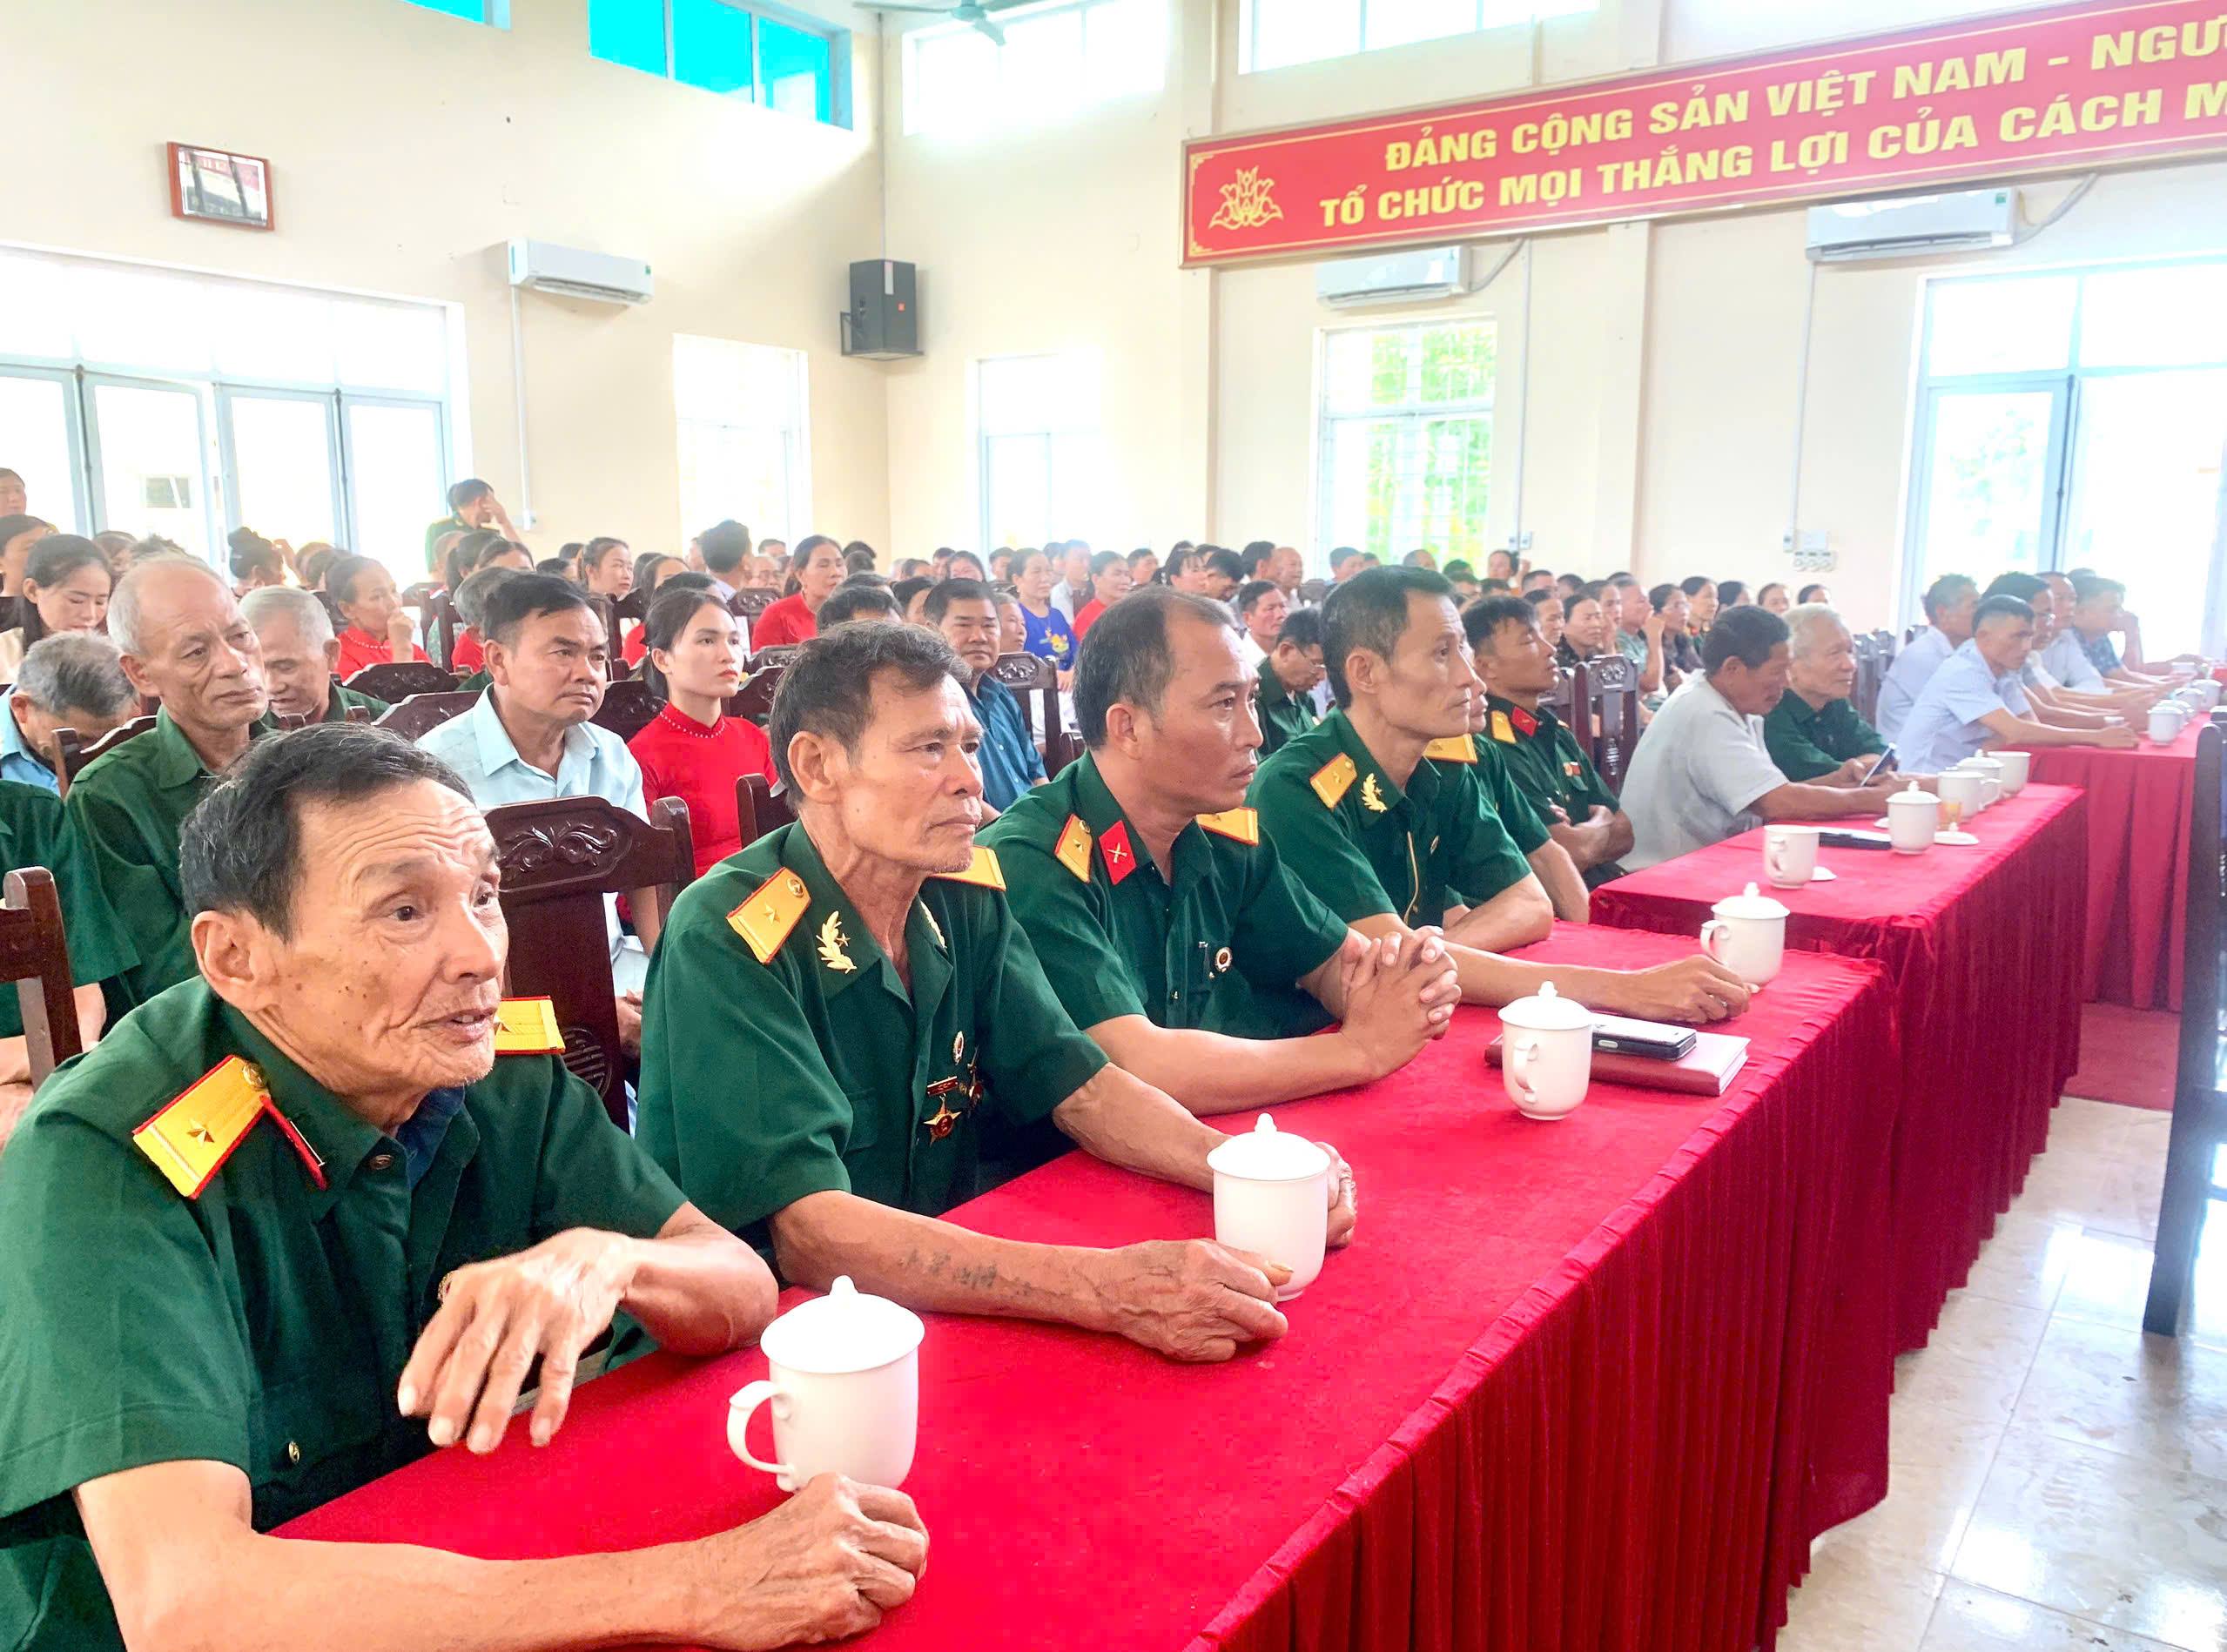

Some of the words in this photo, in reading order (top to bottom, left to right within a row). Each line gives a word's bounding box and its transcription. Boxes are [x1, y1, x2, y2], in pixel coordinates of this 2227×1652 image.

[1319, 184, 1366, 227] TỔ
[1377, 174, 1485, 221] CHỨC
[1498, 168, 1582, 208] MỌI
[1597, 144, 1753, 196] THẮNG
[1769, 131, 1850, 175] LỢI
[1867, 106, 1980, 160] CỦA
[1998, 89, 2163, 144] CÁCH
[1384, 126, 1497, 171] ĐẢNG
[1511, 113, 1633, 155] CỘNG
[1648, 84, 1749, 135] SẢN
[1766, 70, 1877, 118] VIỆT
[1893, 47, 2028, 99] NAM
[2090, 14, 2227, 71] NGƯ
